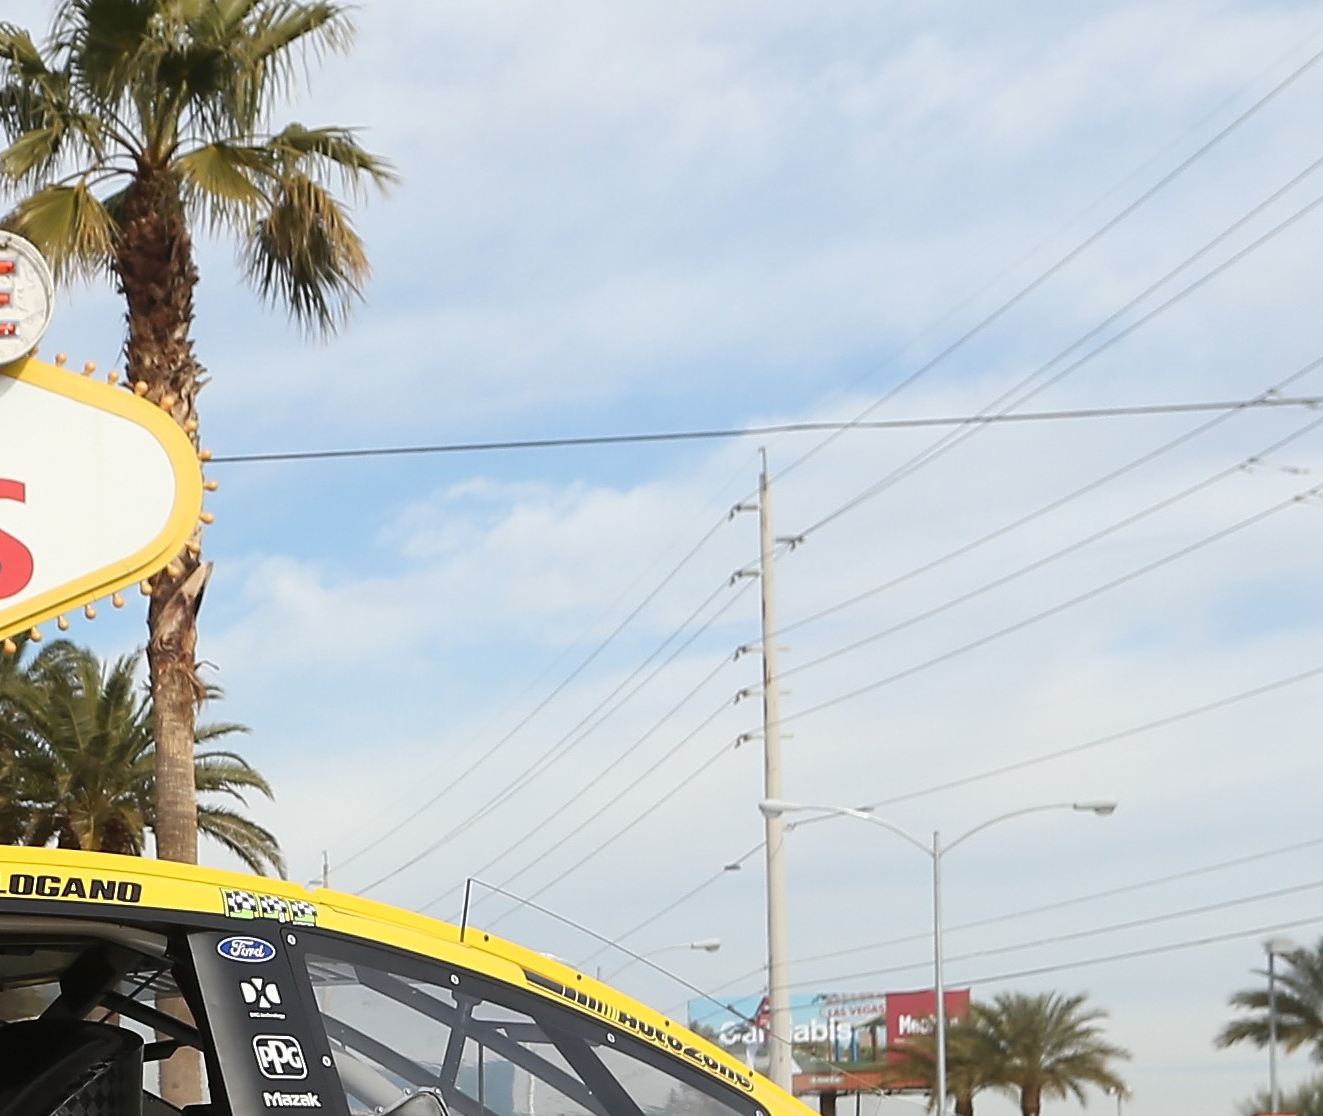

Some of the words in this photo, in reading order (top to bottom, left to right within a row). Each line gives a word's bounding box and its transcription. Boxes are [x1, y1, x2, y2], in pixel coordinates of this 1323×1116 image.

[230, 939, 266, 958] Ford
[718, 1016, 853, 1046] Caabis
[257, 1039, 304, 1075] PPG
[617, 1010, 755, 1093] AutoZone
[263, 1091, 323, 1108] Mazak
